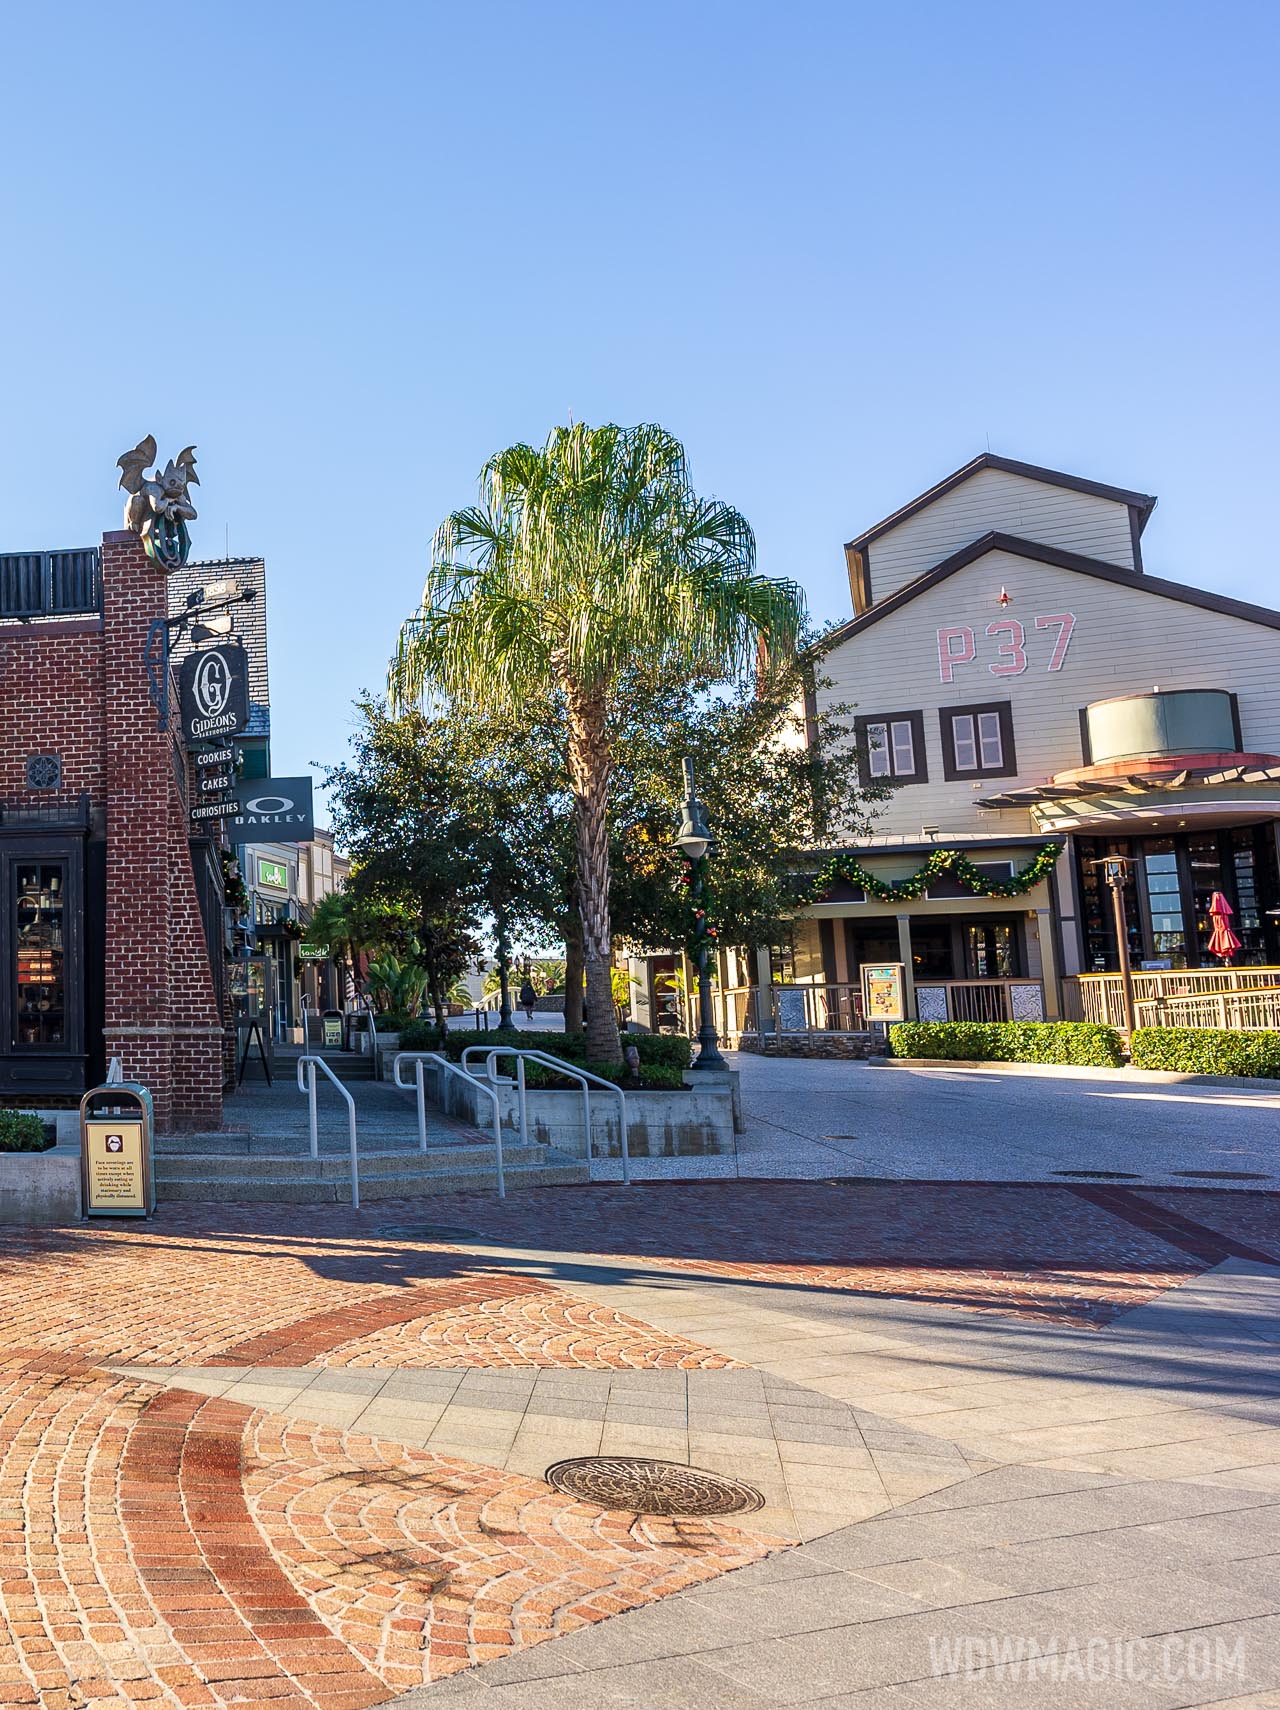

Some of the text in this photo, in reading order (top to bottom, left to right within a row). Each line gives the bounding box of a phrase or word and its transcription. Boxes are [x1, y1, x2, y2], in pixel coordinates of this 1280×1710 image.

[936, 612, 1077, 684] P37
[191, 712, 237, 735] GIDEON'S
[197, 749, 232, 765] COOKIES
[201, 776, 228, 791] CAKES
[191, 802, 239, 819] CURIOSITIES
[235, 814, 306, 825] OAKLEY
